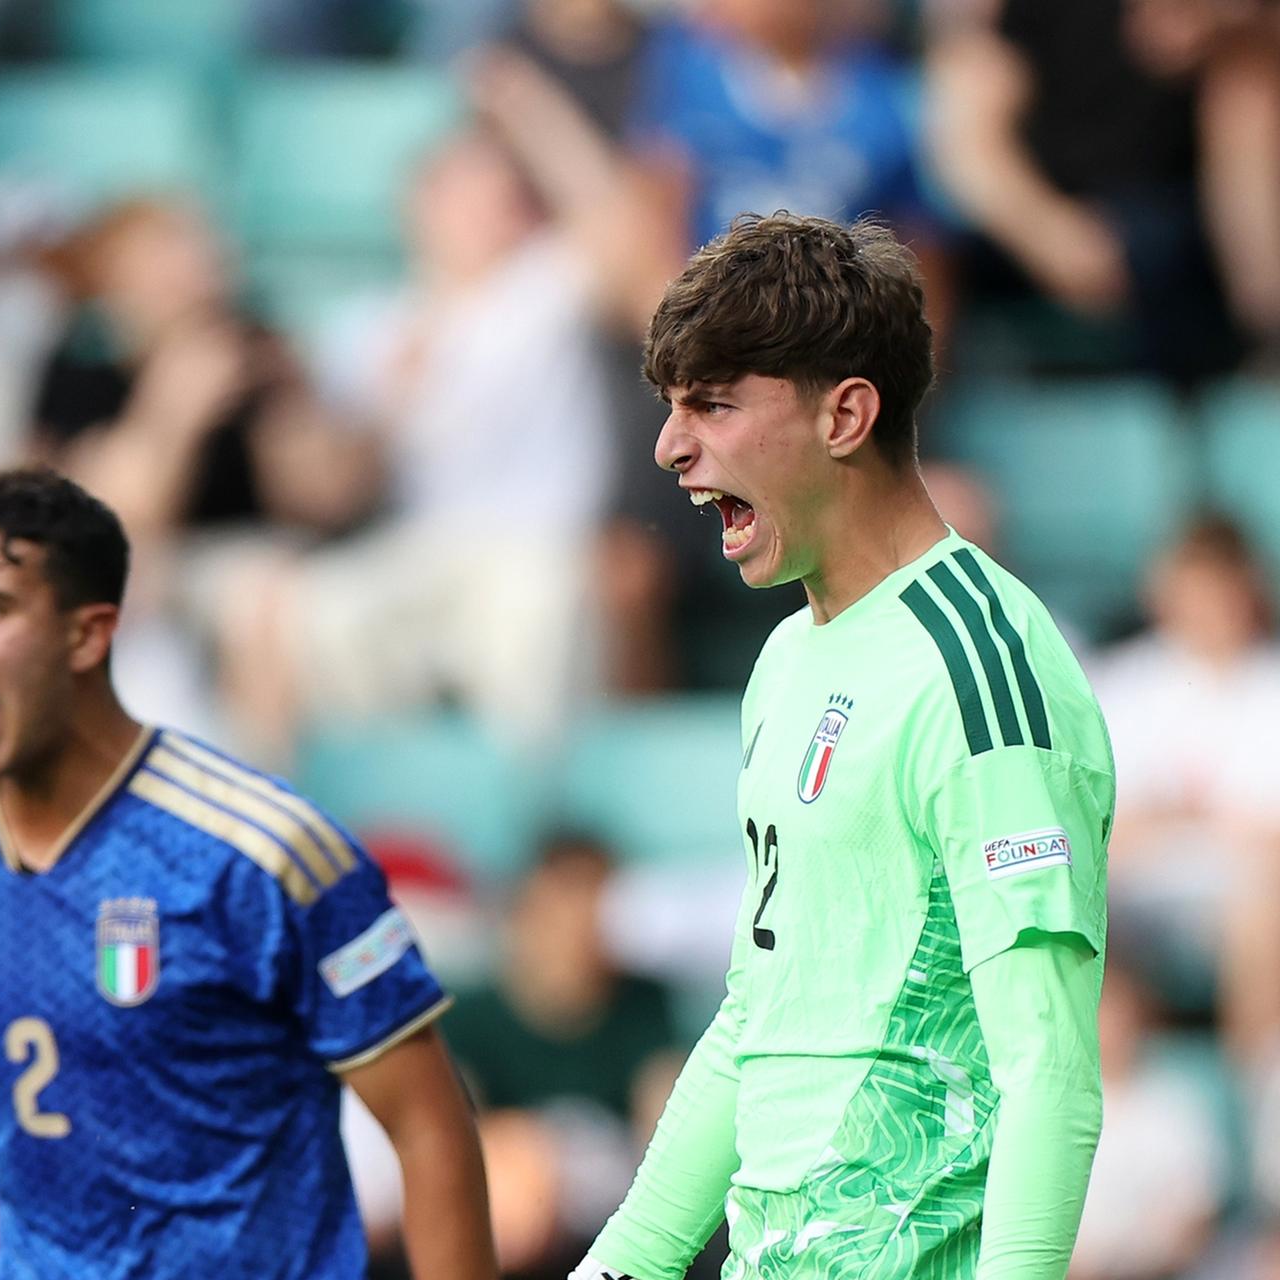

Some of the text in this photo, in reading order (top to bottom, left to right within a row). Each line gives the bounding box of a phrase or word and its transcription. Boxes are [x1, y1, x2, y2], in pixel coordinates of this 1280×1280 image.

[984, 839, 1010, 853] UEFA
[985, 838, 1070, 867] FOUNDAT
[4, 1017, 72, 1139] 2
